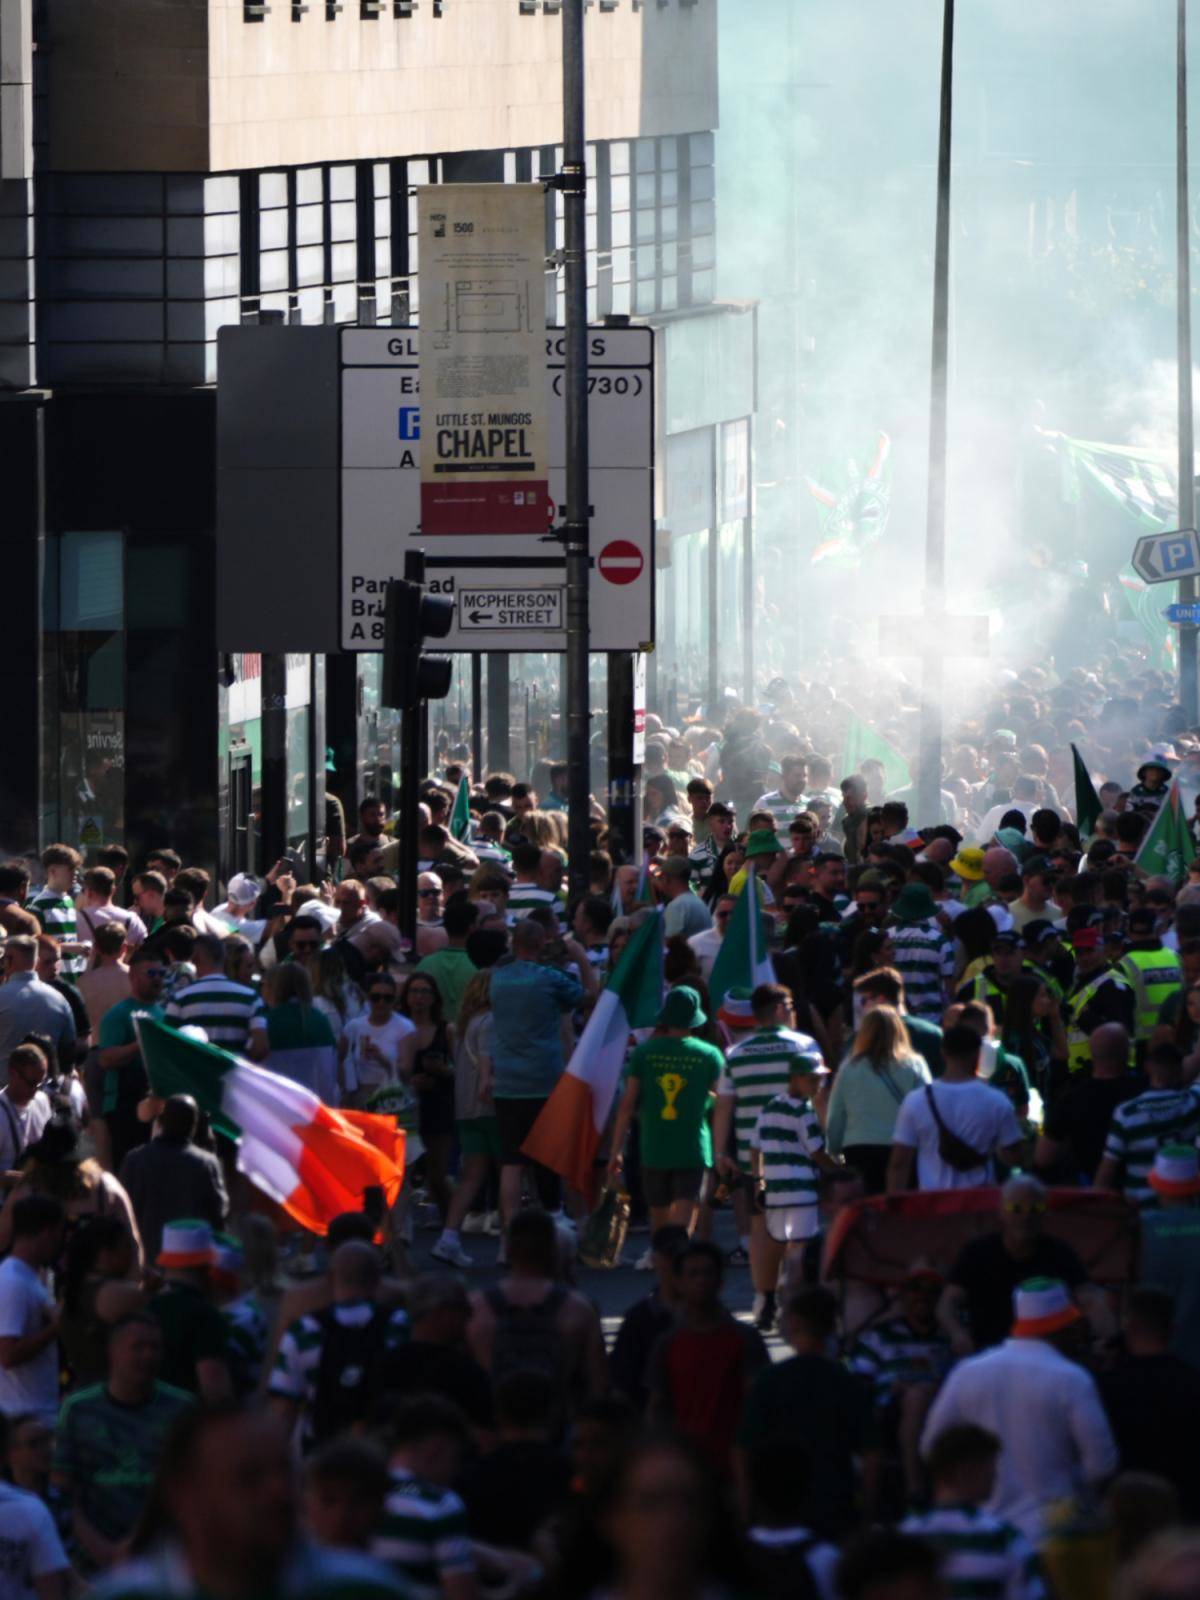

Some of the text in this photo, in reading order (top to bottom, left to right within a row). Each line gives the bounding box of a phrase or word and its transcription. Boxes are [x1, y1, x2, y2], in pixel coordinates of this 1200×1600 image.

[552, 376, 643, 396] (730)
[436, 413, 532, 426] LITTLE ST. MUNGOS
[437, 428, 532, 459] CHAPEL
[1168, 543, 1186, 569] P
[464, 594, 557, 609] MCPHERSON
[498, 610, 553, 624] STREET
